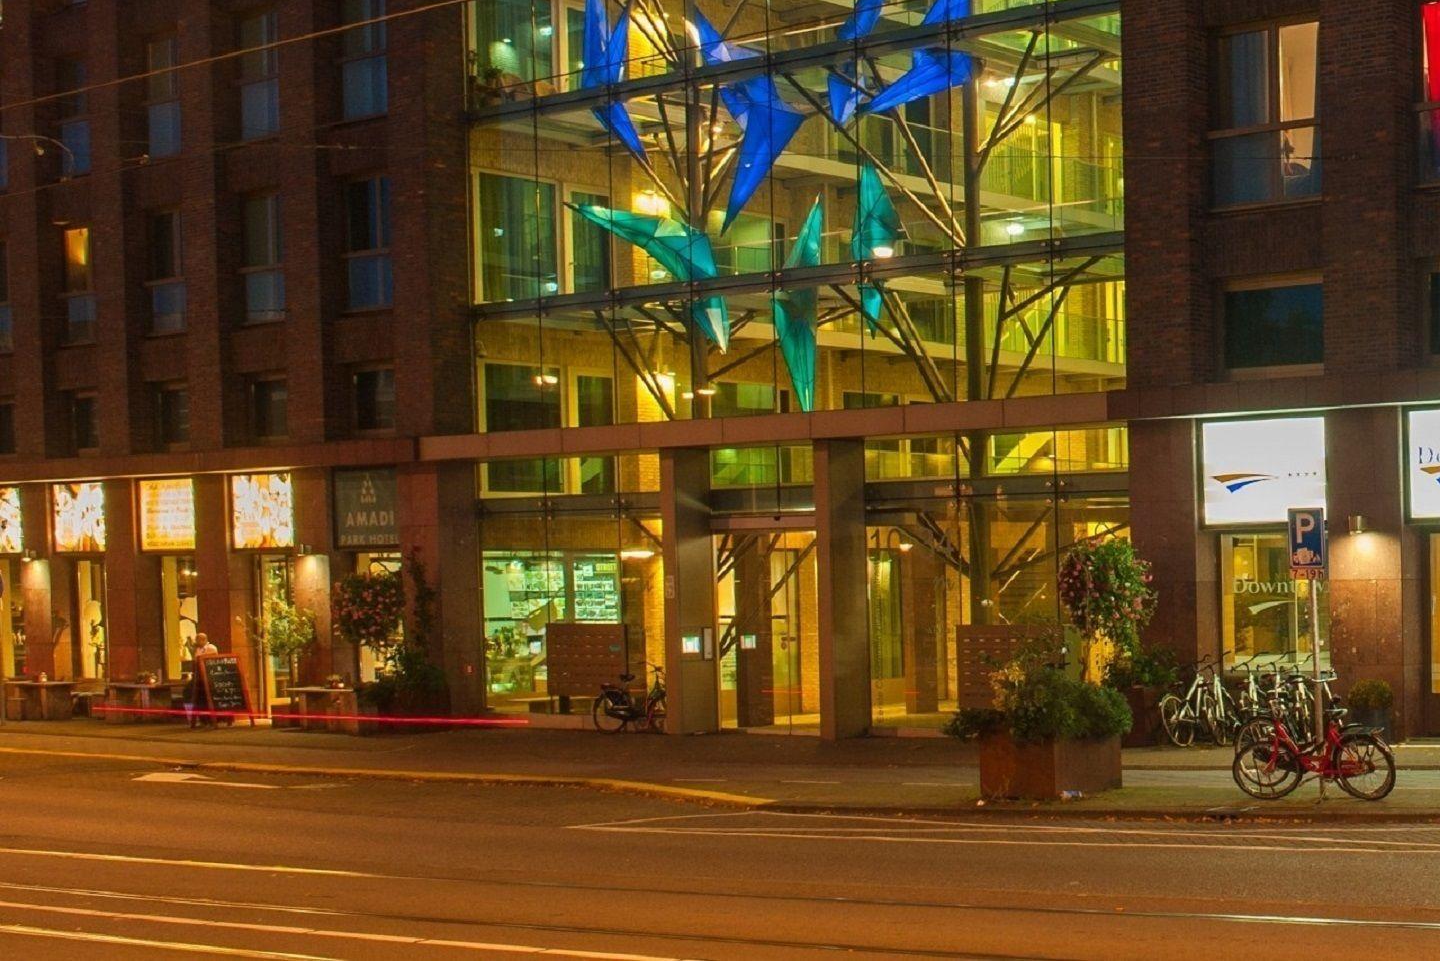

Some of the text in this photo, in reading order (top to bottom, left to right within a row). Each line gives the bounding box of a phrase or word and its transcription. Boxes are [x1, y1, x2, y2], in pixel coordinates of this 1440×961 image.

[345, 511, 394, 527] AMADI
[1295, 512, 1315, 544] P
[340, 533, 400, 545] PARK HOTEL
